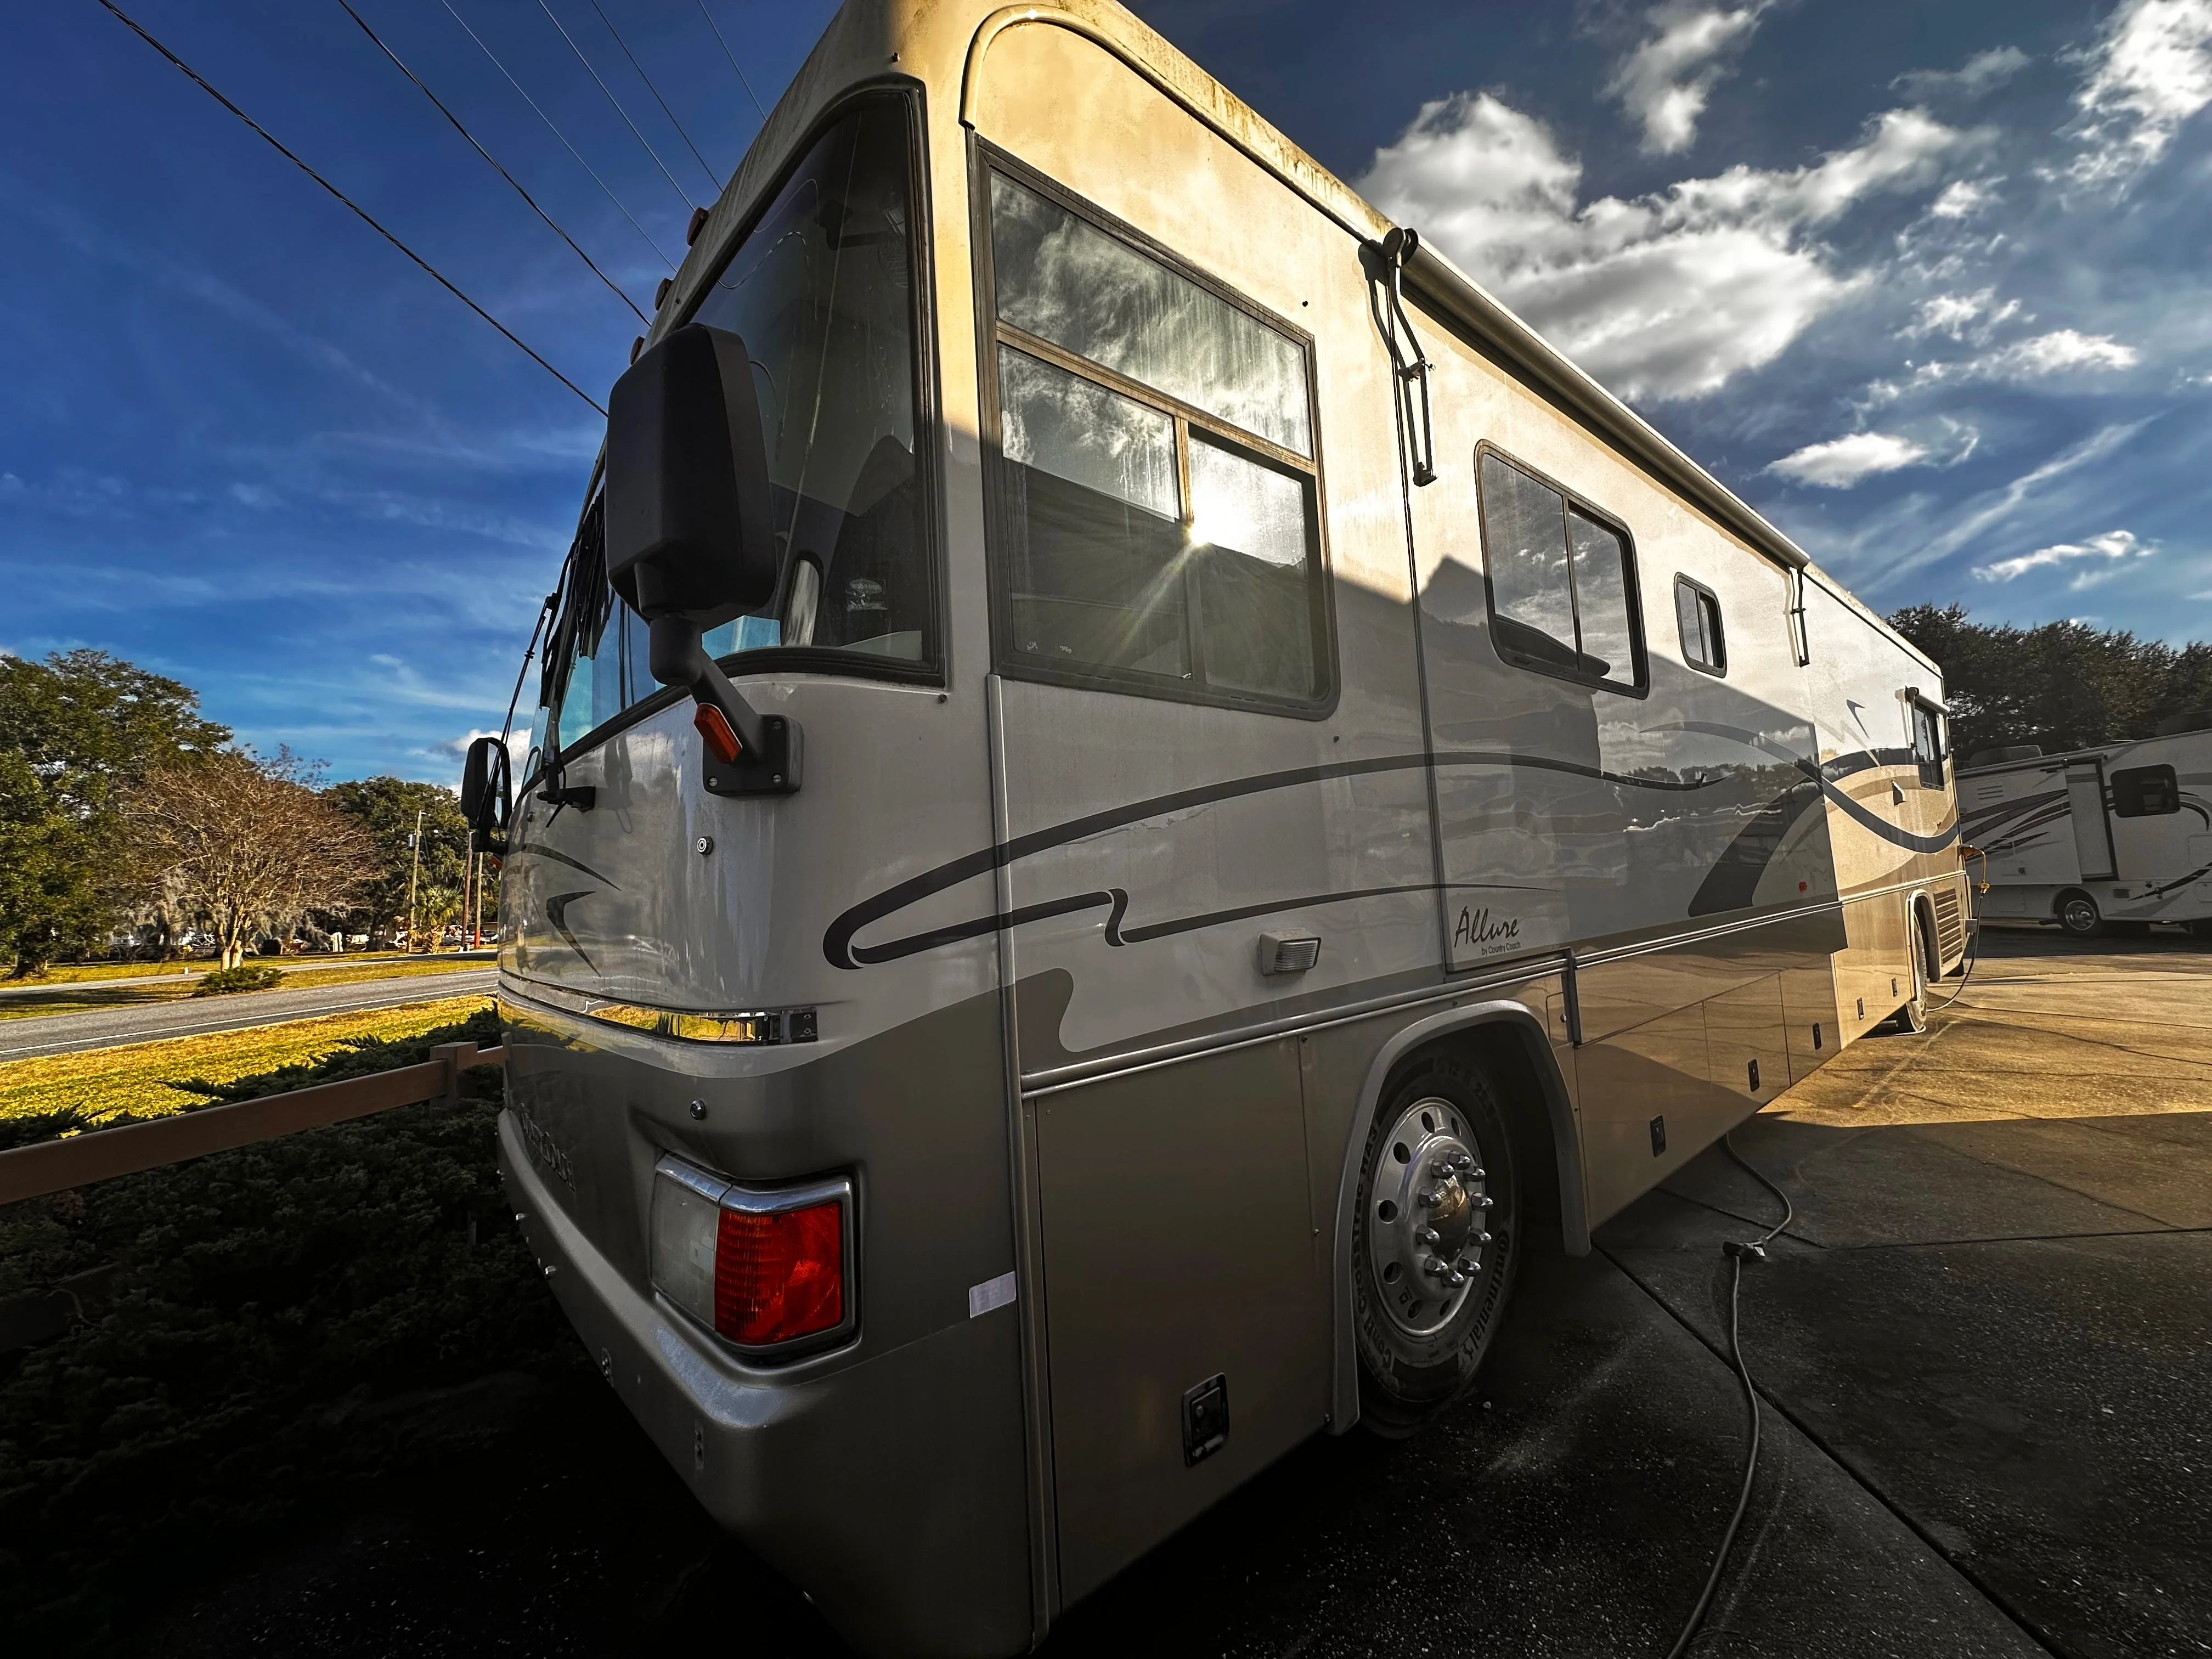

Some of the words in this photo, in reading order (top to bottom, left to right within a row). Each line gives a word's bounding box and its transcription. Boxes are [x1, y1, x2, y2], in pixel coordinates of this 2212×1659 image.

[1454, 906, 1519, 947] Allure
[1482, 947, 1487, 956] by
[1488, 945, 1505, 954] Country
[1506, 941, 1521, 951] Coach
[1470, 1230, 1510, 1350] Continental
